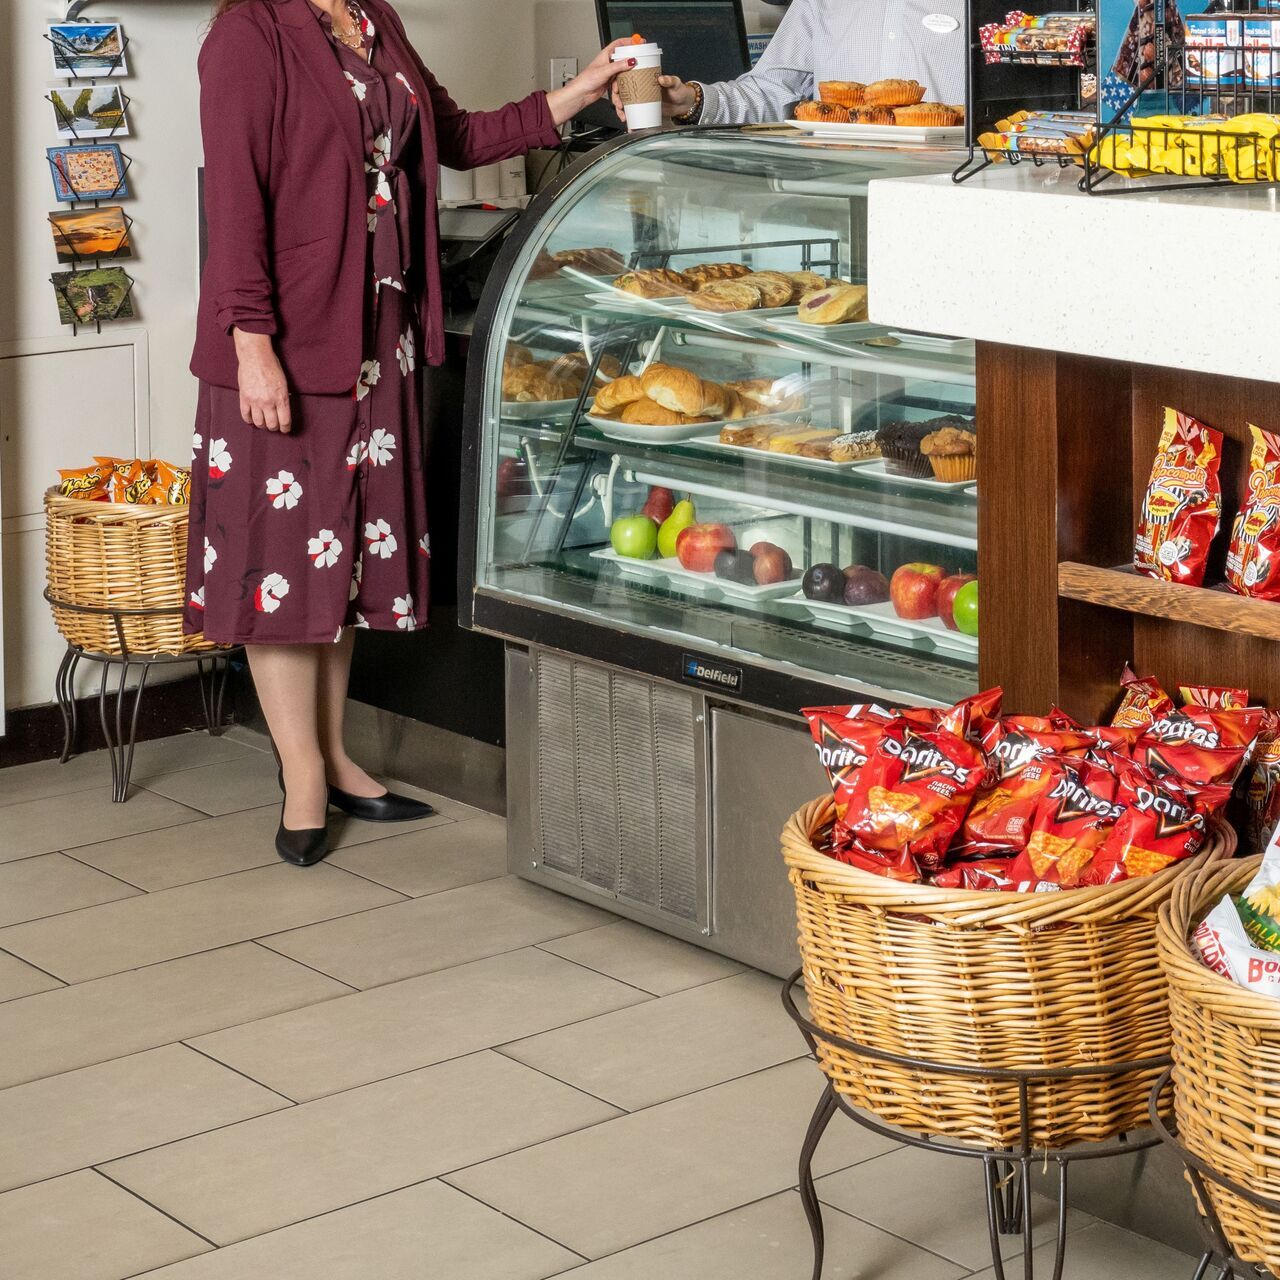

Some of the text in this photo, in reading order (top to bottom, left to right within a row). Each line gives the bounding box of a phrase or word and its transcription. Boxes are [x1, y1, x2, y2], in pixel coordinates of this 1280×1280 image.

[697, 665, 738, 688] Delfield
[815, 742, 867, 767] orito
[884, 737, 970, 783] Doritos
[1022, 770, 1041, 781] EESE
[1028, 766, 1042, 774] CHO
[932, 780, 956, 793] NACHO
[1050, 779, 1125, 818] Doritos
